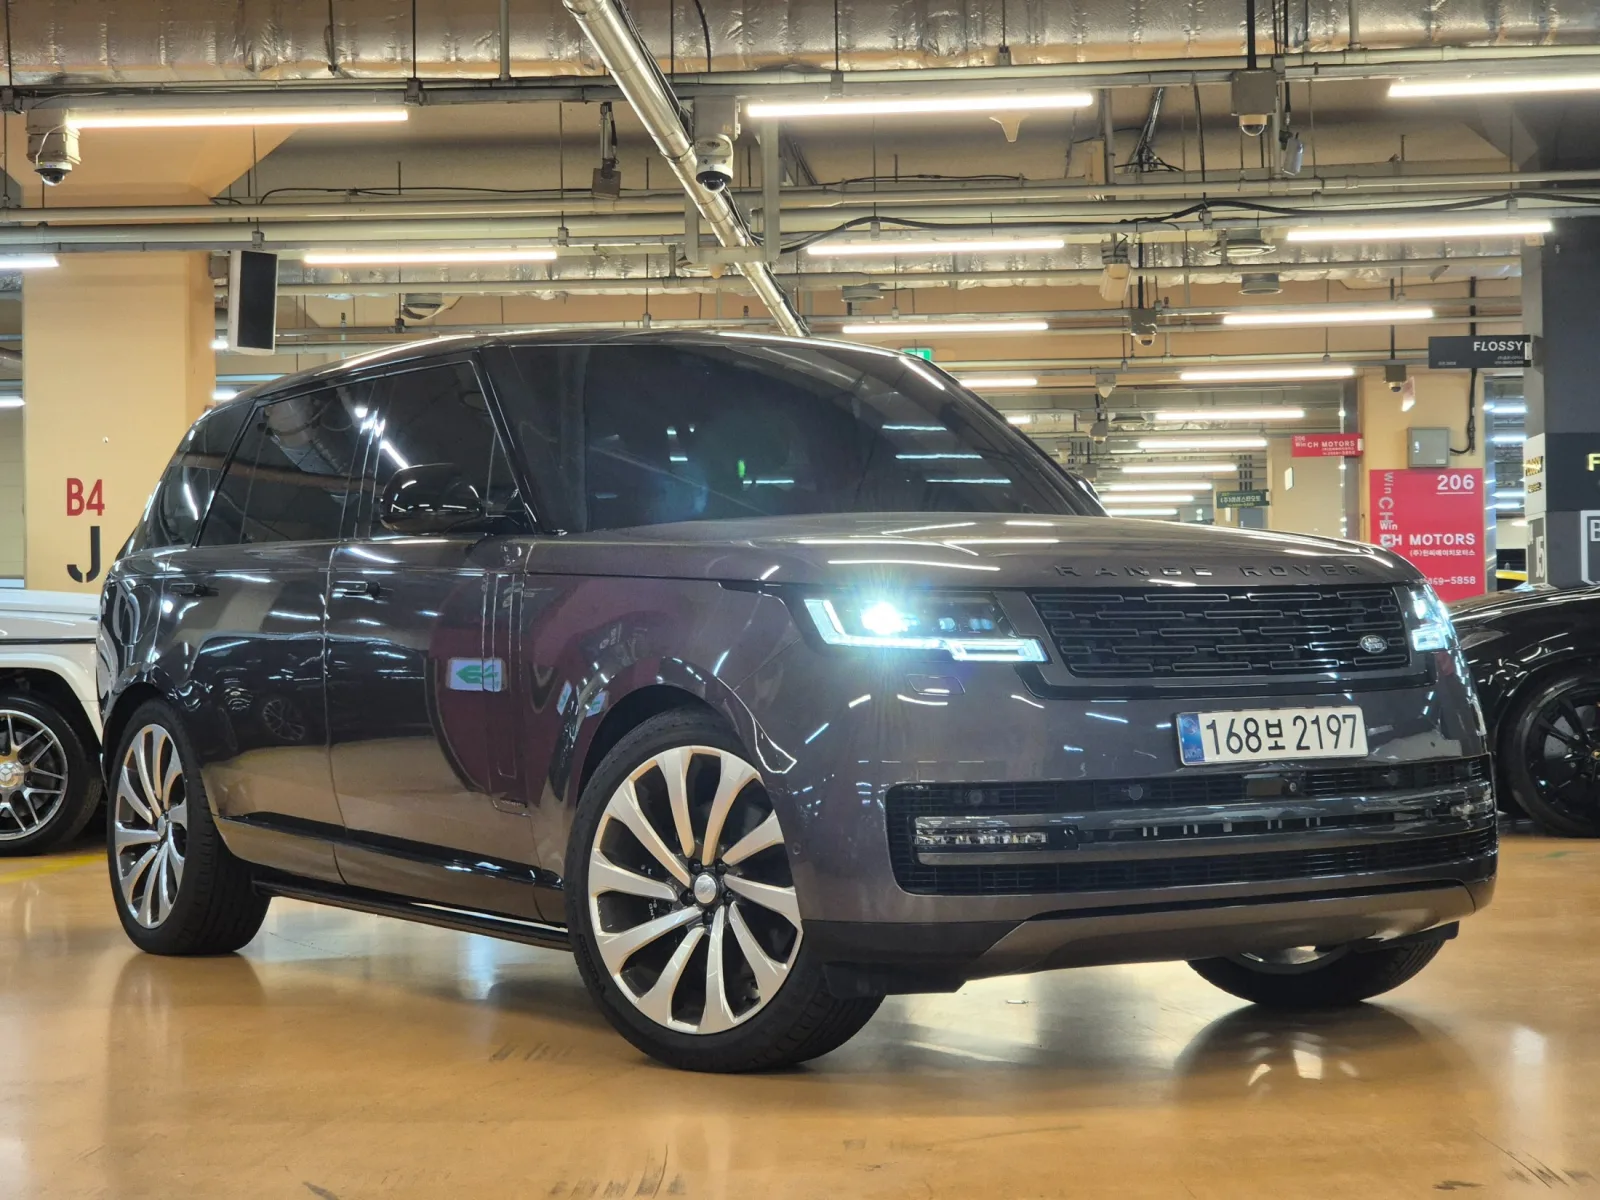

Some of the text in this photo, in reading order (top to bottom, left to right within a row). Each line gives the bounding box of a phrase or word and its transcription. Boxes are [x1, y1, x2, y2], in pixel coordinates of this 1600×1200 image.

[1473, 341, 1523, 352] FLOSSY
[1321, 440, 1355, 448] MOTORS
[1437, 474, 1475, 491] 206
[66, 477, 105, 516] B4
[1379, 522, 1398, 531] Win
[1409, 533, 1475, 546] MOTORS
[66, 525, 100, 583] J
[1054, 564, 1362, 577] RANGE ROVER
